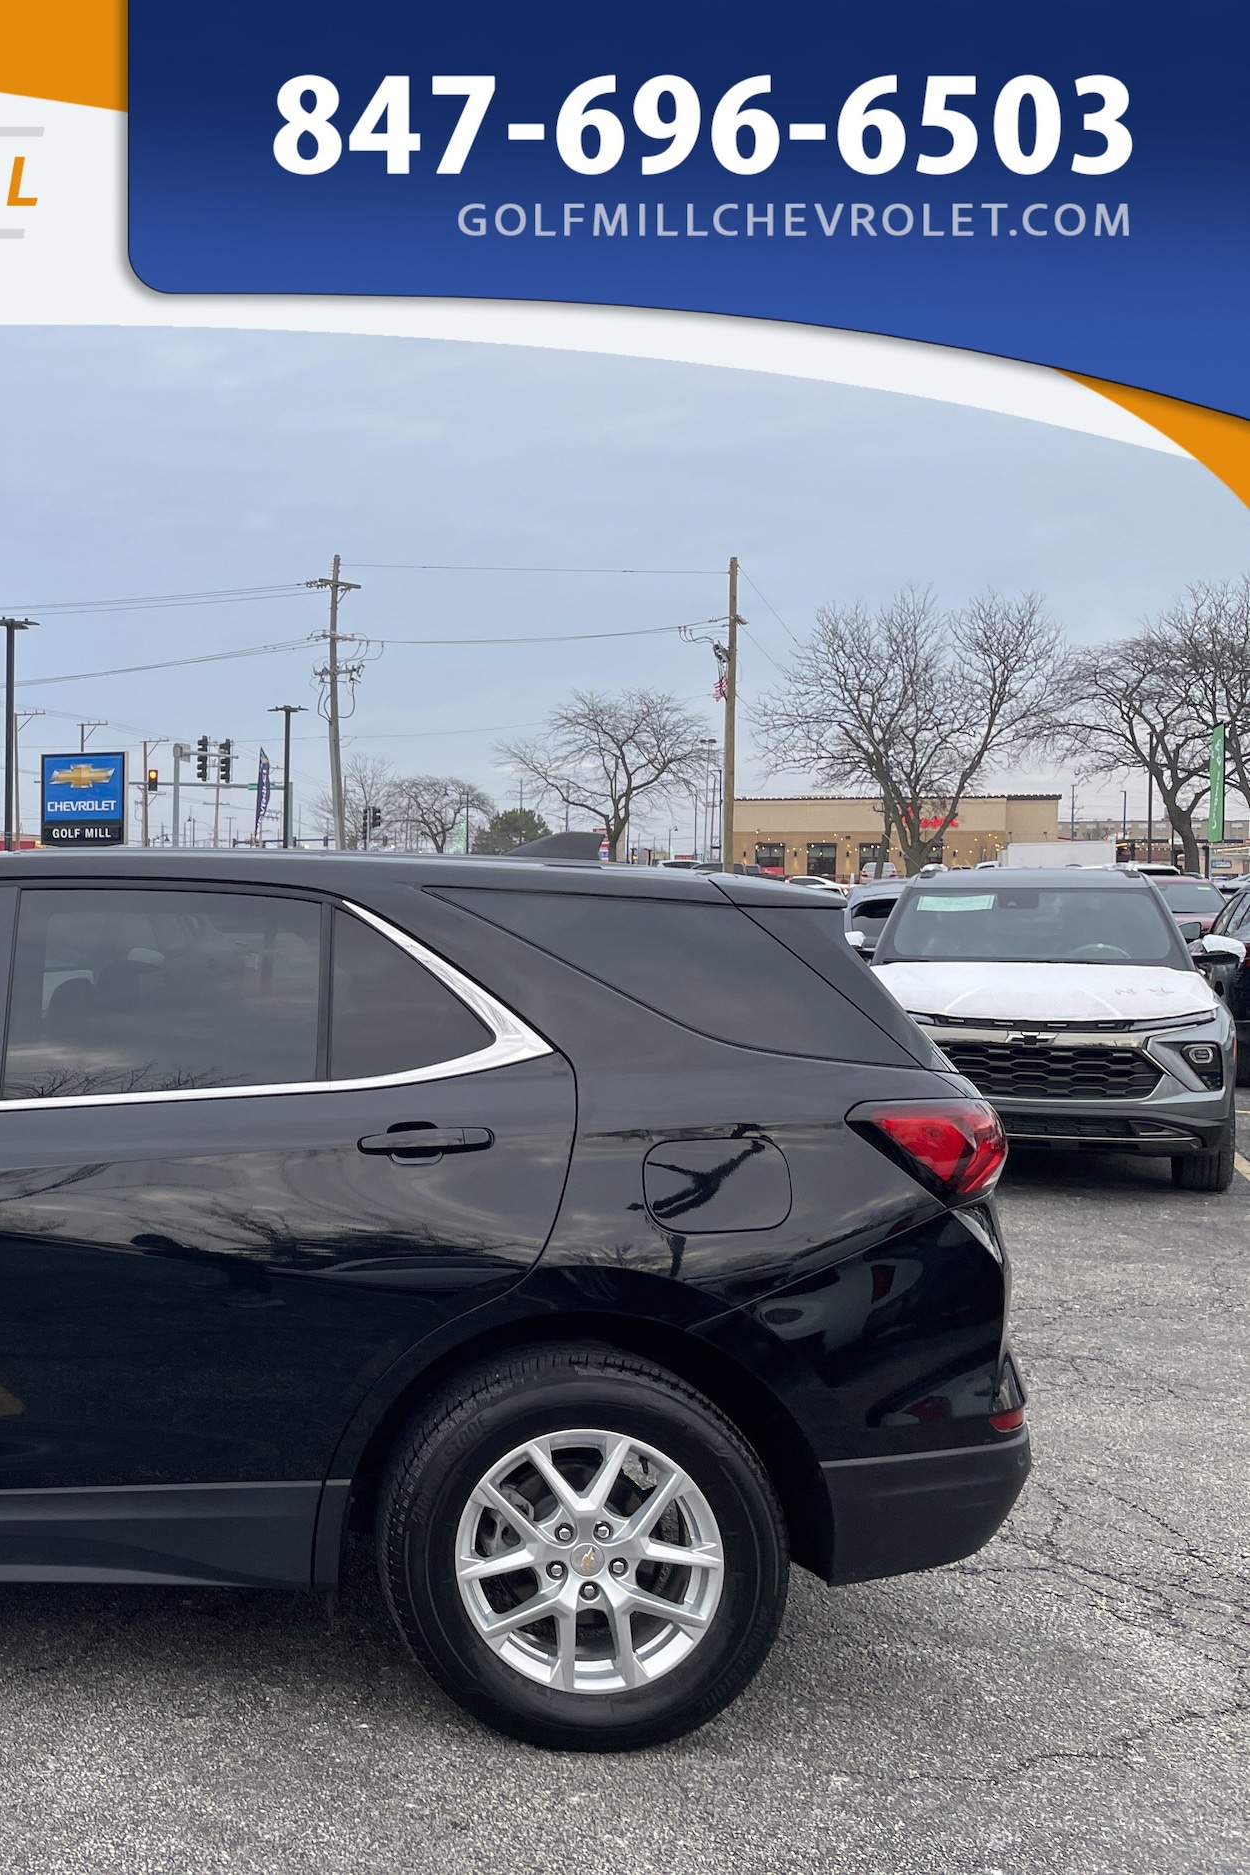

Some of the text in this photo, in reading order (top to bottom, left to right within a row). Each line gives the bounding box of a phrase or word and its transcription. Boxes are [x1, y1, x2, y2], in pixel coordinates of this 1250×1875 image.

[47, 800, 116, 812] CHEVROLET
[52, 827, 111, 839] GOLF MILL
